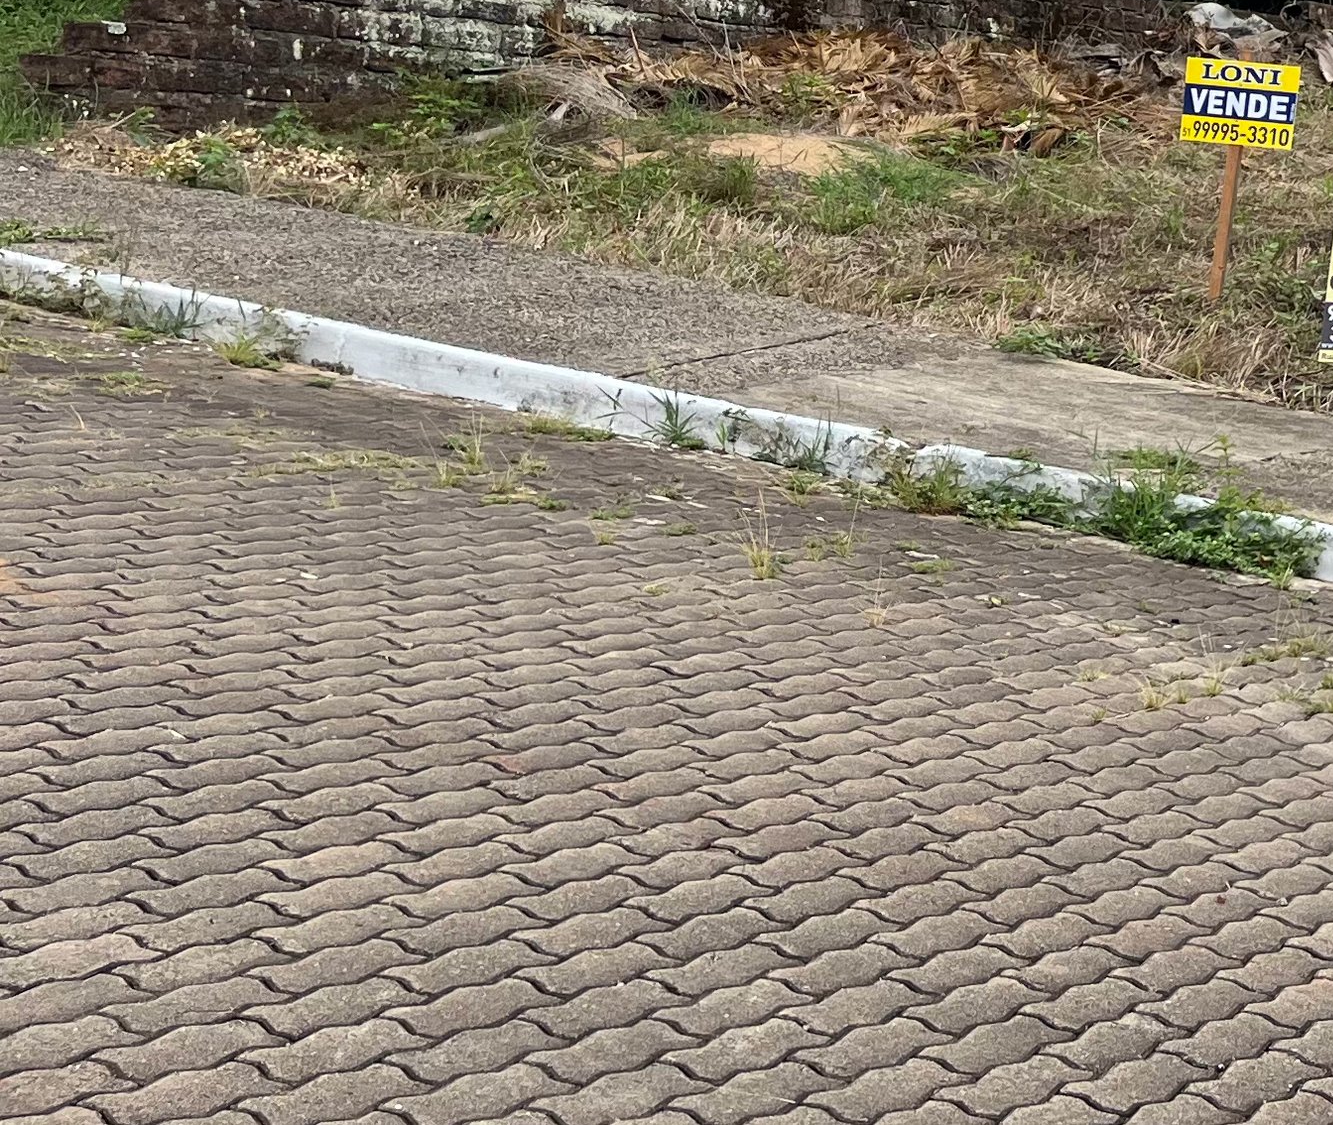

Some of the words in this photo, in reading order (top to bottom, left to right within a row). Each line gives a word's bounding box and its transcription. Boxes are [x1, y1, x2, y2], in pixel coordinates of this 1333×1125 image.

[1202, 64, 1281, 85] LONI
[1191, 88, 1290, 121] VENDE
[1182, 127, 1191, 136] 51
[1193, 120, 1290, 146] 99995-3310
